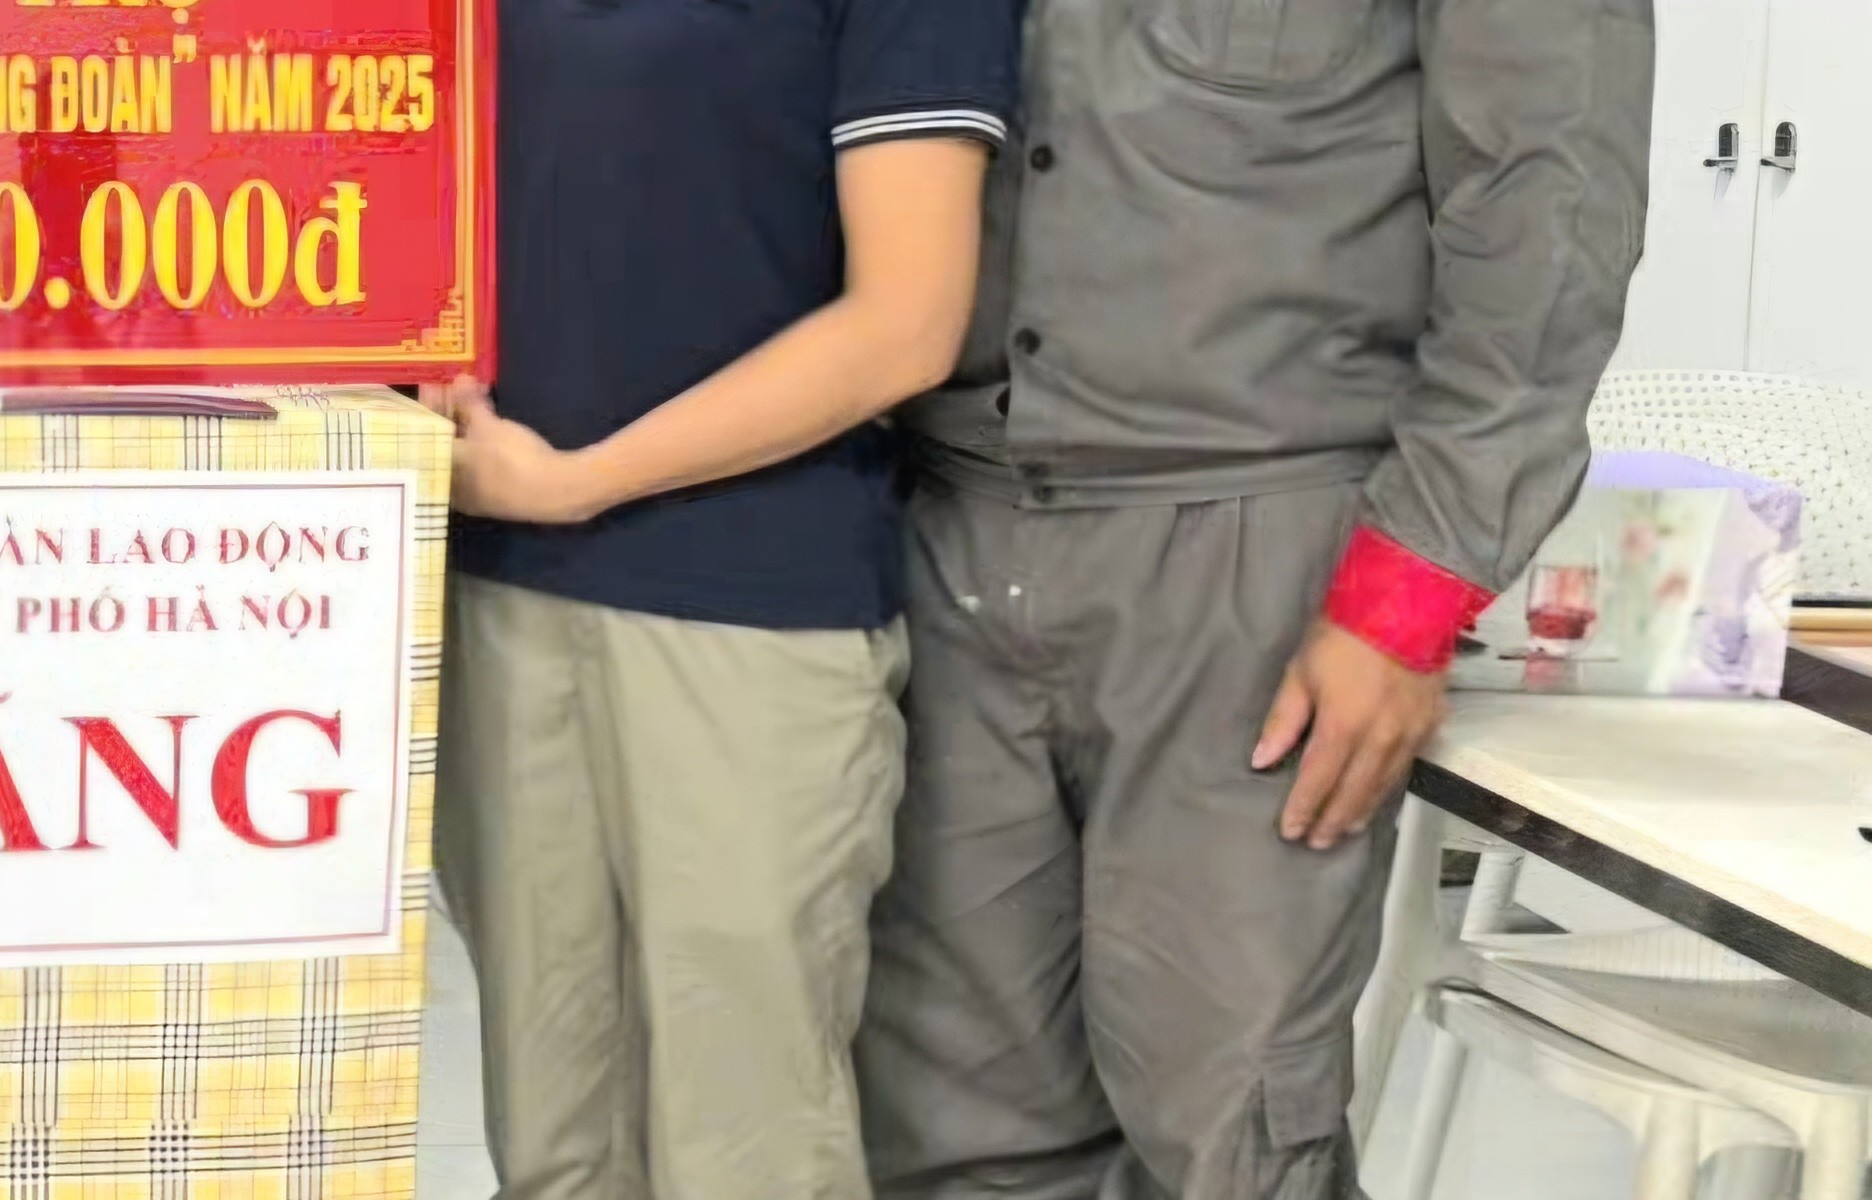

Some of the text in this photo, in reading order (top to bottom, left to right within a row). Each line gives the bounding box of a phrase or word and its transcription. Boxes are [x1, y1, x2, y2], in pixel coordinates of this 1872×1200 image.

[210, 37, 313, 133] NĂM
[326, 54, 434, 133] 2025
[86, 528, 196, 564] LAO
[217, 521, 369, 572] ĐỘNG
[238, 588, 331, 639] NỘI
